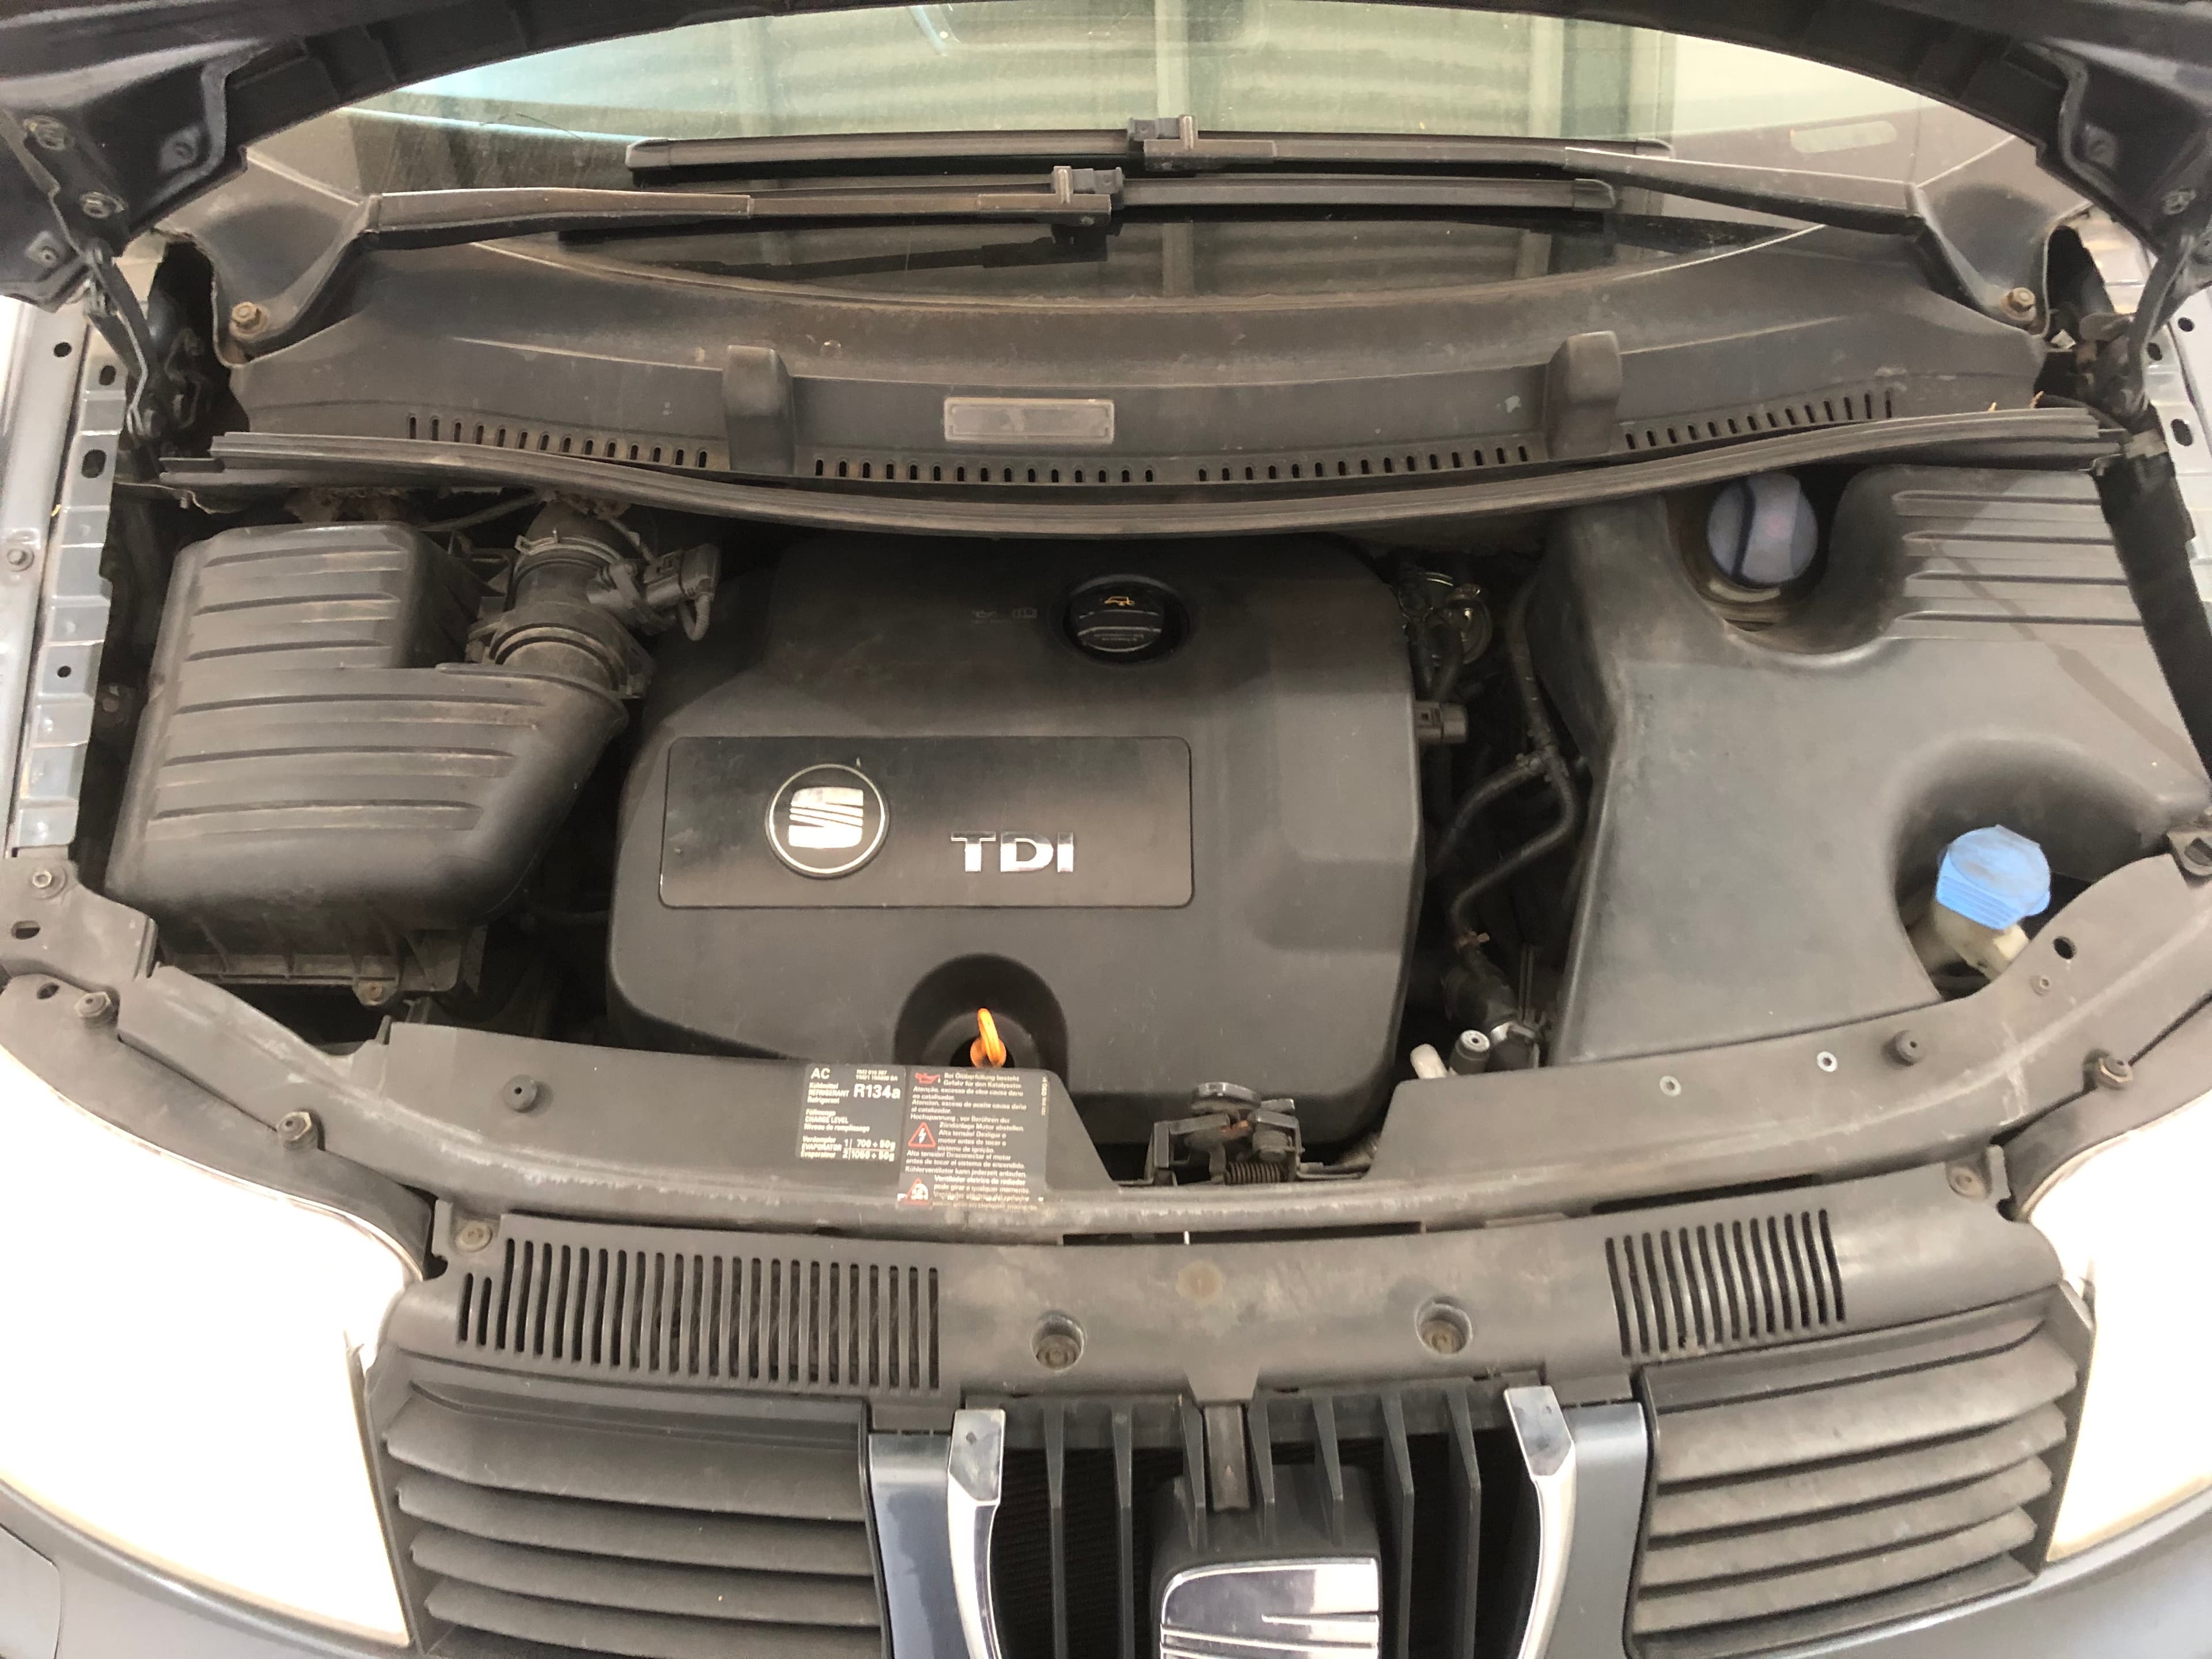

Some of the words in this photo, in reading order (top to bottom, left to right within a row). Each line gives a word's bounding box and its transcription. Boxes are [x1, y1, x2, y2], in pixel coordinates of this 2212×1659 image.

[951, 831, 1073, 872] TDI
[811, 1067, 830, 1080] AC
[853, 1084, 900, 1099] R134a
[844, 1139, 849, 1147] 1
[857, 1139, 872, 1147] 700
[842, 1150, 849, 1158] 2
